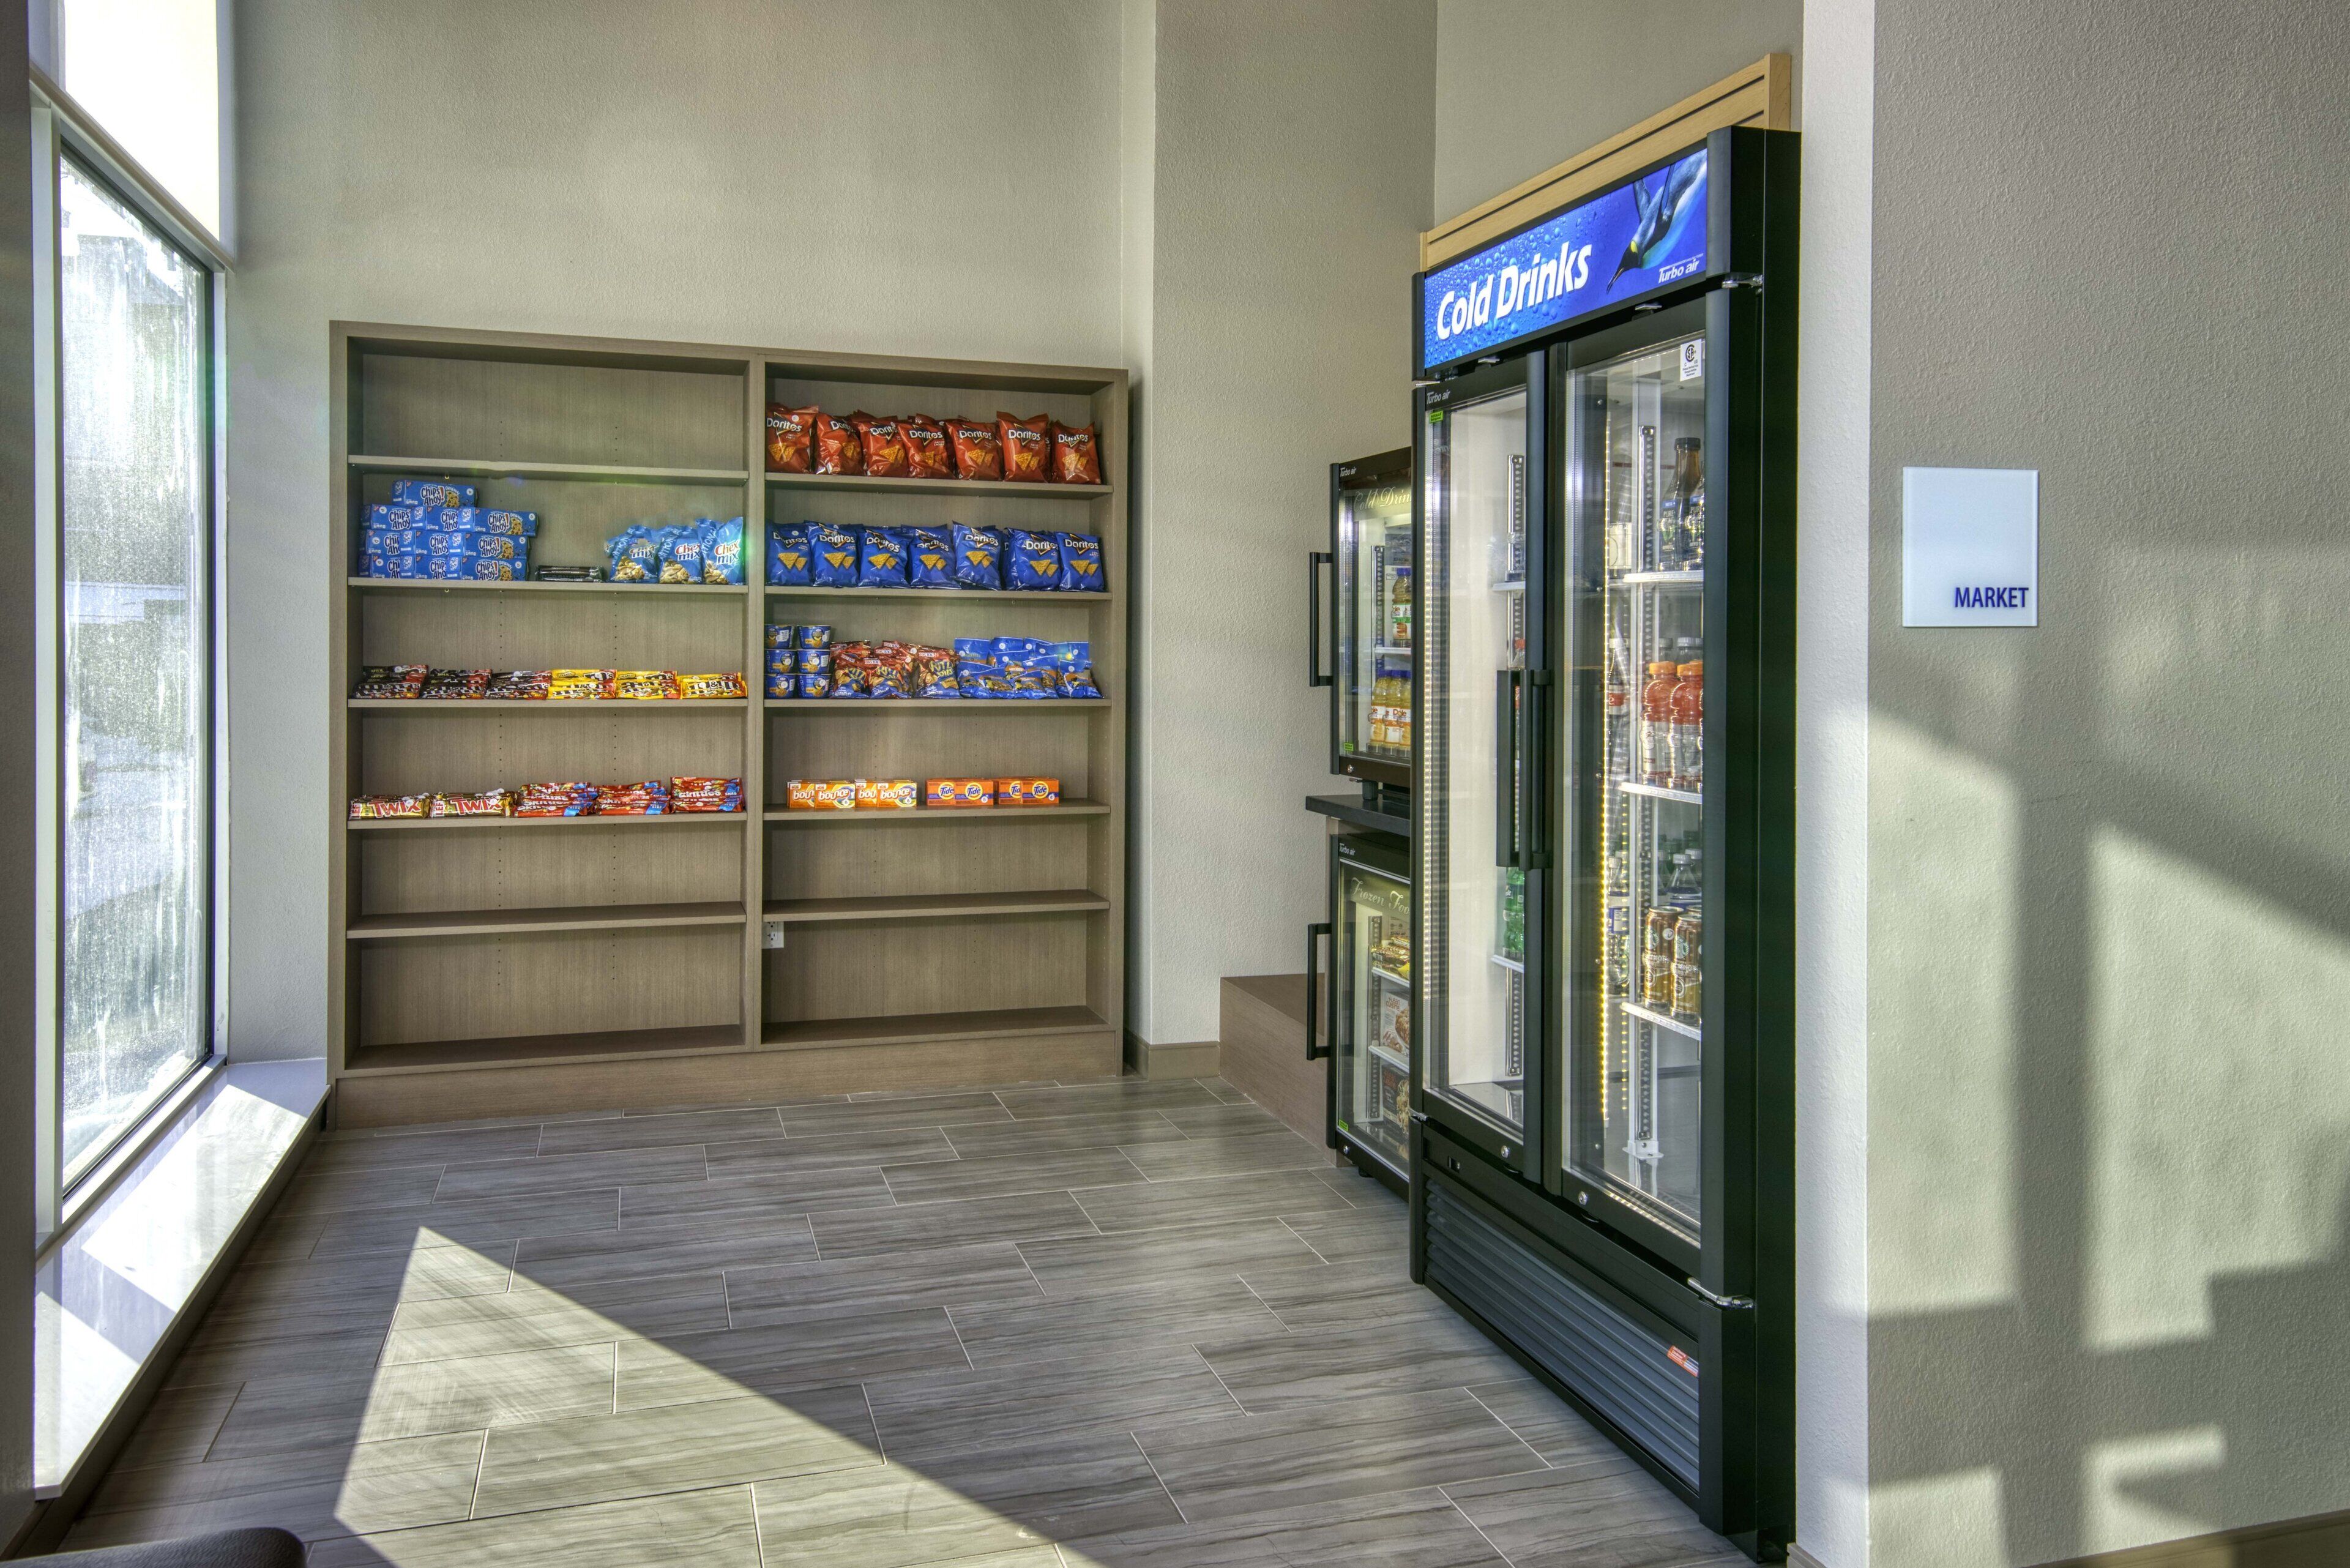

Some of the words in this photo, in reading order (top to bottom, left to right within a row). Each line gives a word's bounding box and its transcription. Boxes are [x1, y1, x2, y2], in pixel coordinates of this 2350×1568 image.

[1658, 266, 1684, 284] Turbo
[1685, 257, 1699, 274] air
[1437, 275, 1494, 340] Cold
[1497, 241, 1592, 318] Drinks
[1427, 391, 1441, 405] Turbo
[1442, 389, 1450, 400] air
[767, 417, 802, 432] Doritos
[909, 430, 943, 439] Doritos
[959, 430, 992, 440] Doritos
[1009, 430, 1041, 441] Doritos
[1340, 467, 1351, 477] Turbo
[421, 486, 440, 499] Chips
[1353, 488, 1379, 512] Cold
[1380, 487, 1411, 507] Drin
[389, 510, 409, 522] Chips
[488, 513, 505, 526] Chips
[430, 535, 448, 548] Chips
[479, 537, 496, 549] Chips
[819, 534, 855, 543] Doritos
[965, 534, 998, 547] Doritos
[1065, 539, 1099, 550] Doritos
[676, 543, 701, 554] Chex
[715, 542, 739, 555] Chex
[678, 550, 701, 561] mix
[717, 552, 739, 565] mix
[387, 560, 400, 572] Chi
[476, 561, 494, 573] Chips
[1955, 587, 2029, 608] MARKET
[793, 790, 814, 800] boun
[819, 790, 849, 801] bounce
[859, 789, 876, 799] bou
[881, 788, 911, 799] bounce
[941, 786, 954, 796] Tide
[967, 786, 981, 796] Tide
[1034, 786, 1047, 796] Tide
[368, 801, 420, 818] TWIX
[452, 799, 502, 815] TWIX
[1340, 843, 1349, 854] Turbo
[1351, 877, 1385, 907] Frozen
[1388, 890, 1410, 915] Foo
